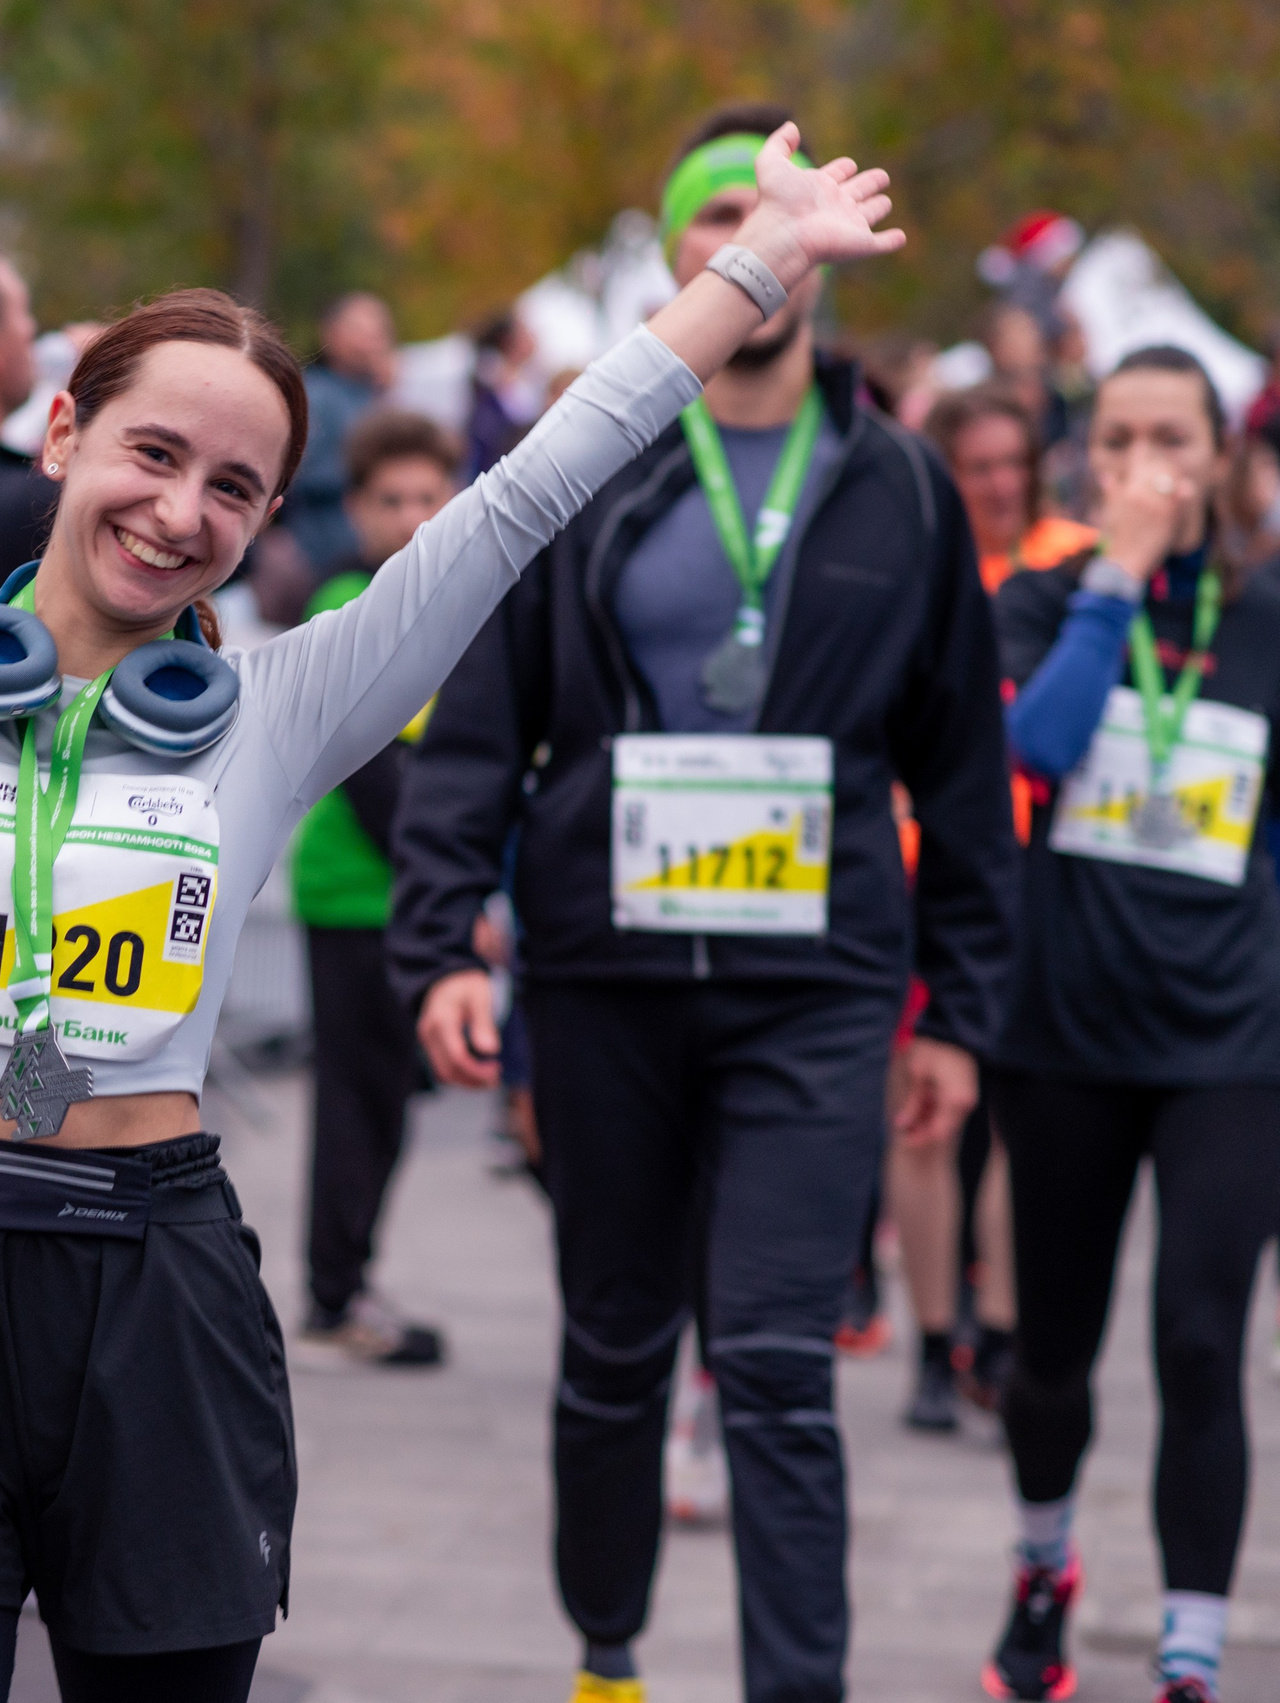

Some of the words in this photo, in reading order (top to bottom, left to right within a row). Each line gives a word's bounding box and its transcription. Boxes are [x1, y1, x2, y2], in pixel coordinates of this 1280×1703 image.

[128, 795, 184, 817] Carlsberg
[97, 831, 183, 850] НЕЗЛАМНОСТІ
[183, 845, 213, 858] 2024
[659, 845, 787, 889] 11712
[74, 1206, 129, 1221] DEMIX
